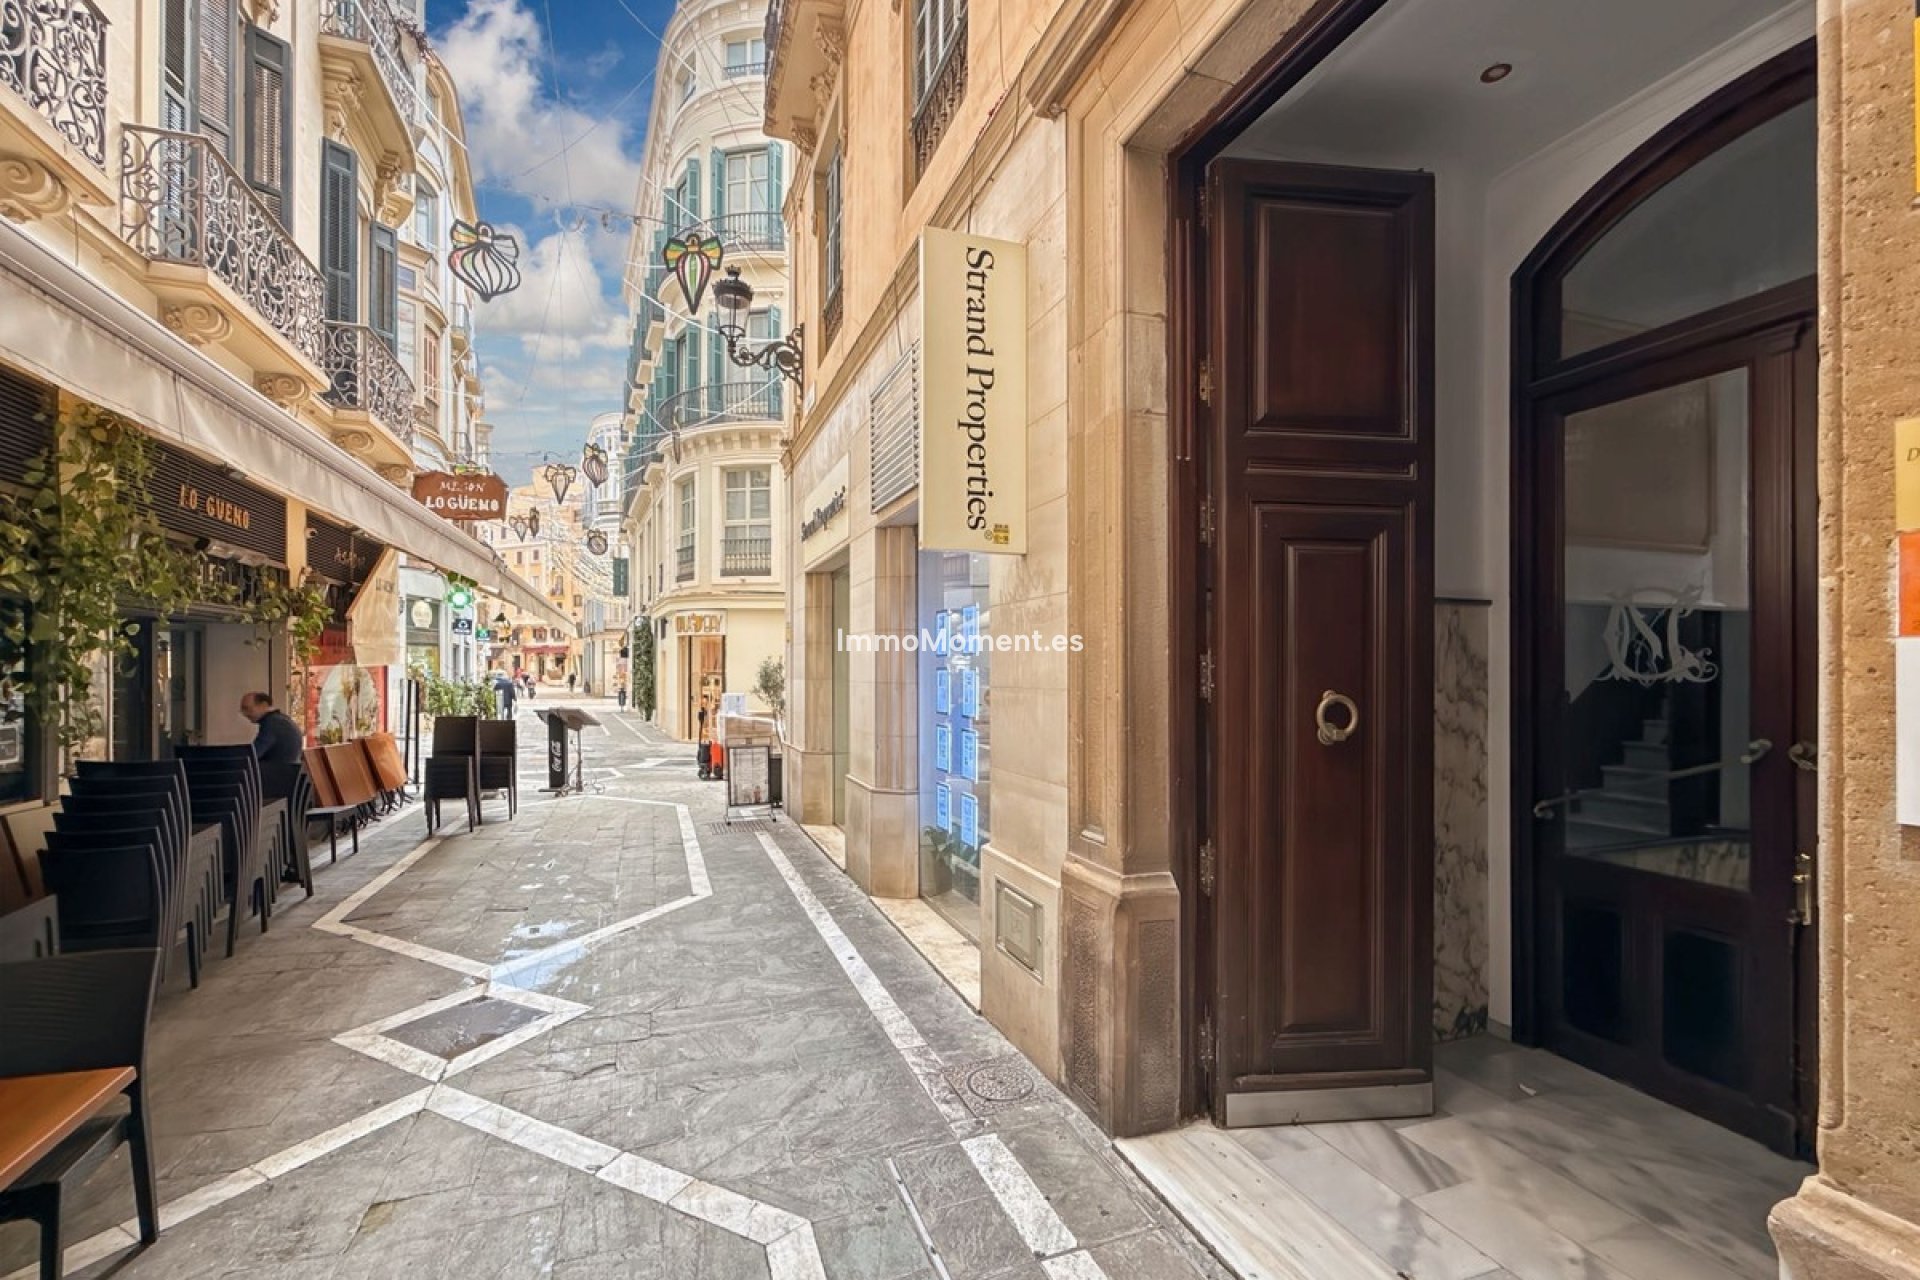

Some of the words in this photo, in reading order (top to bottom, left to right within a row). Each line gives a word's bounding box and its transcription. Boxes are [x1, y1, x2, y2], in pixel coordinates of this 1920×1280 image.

[966, 247, 994, 356] Strand
[425, 495, 445, 508] LO
[957, 363, 995, 531] Properties
